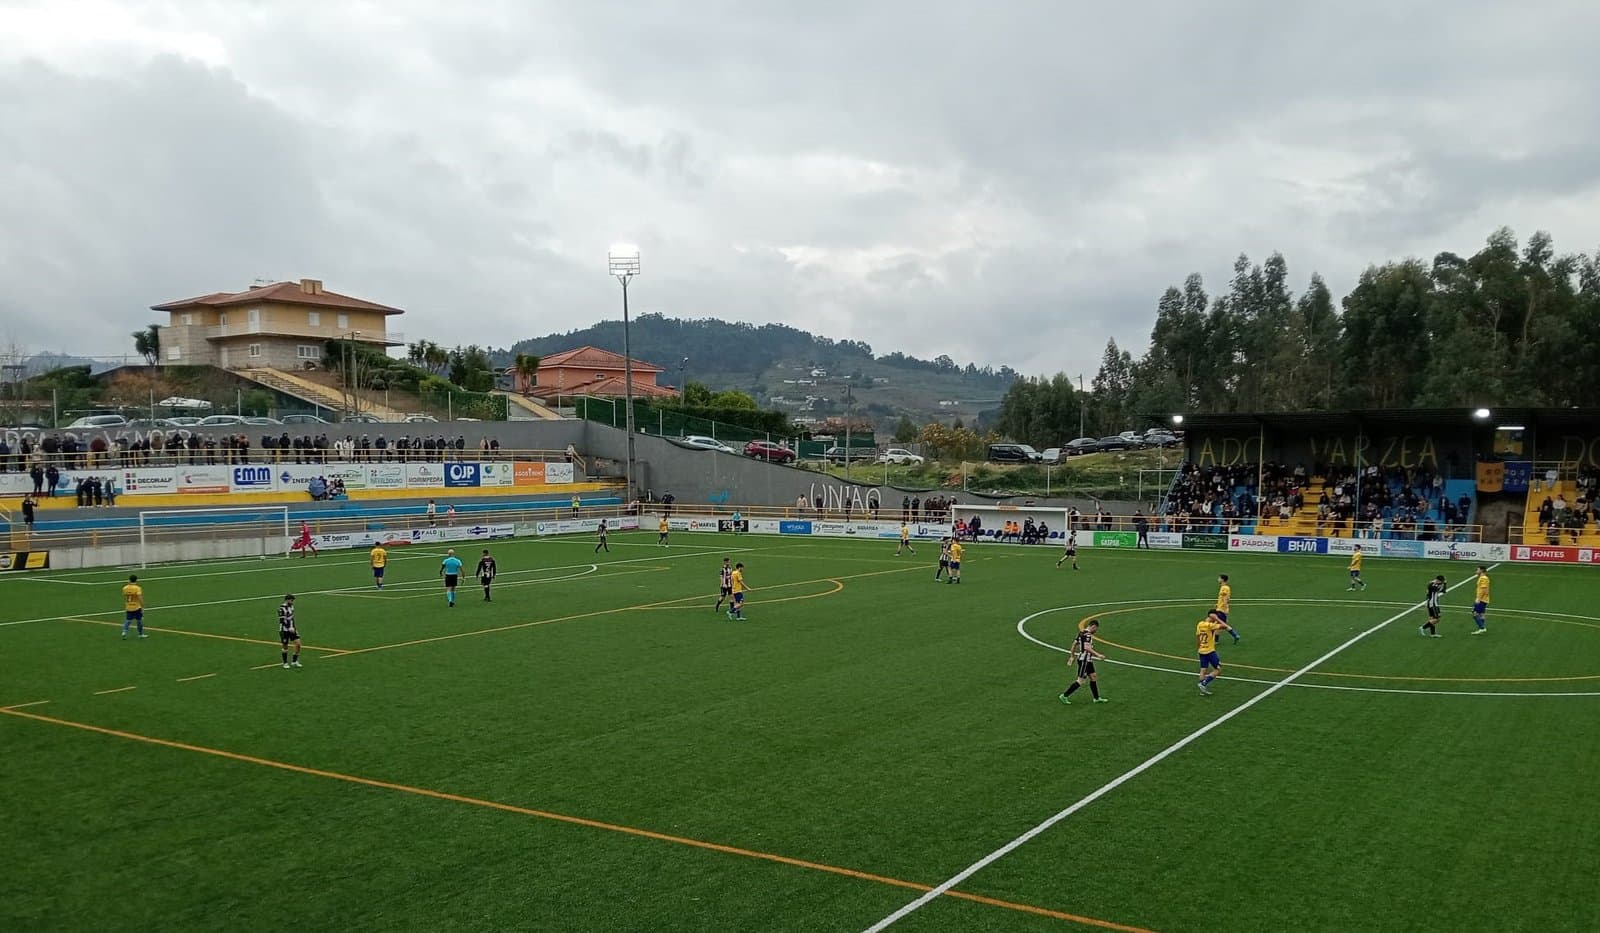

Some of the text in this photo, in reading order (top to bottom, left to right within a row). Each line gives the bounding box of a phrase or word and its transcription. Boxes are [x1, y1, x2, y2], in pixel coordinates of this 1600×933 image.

[233, 467, 271, 482] EMM
[450, 465, 475, 480] OJP
[810, 482, 881, 513] UNIÃO
[1288, 540, 1317, 552] BHM
[1531, 550, 1565, 559] FONTES
